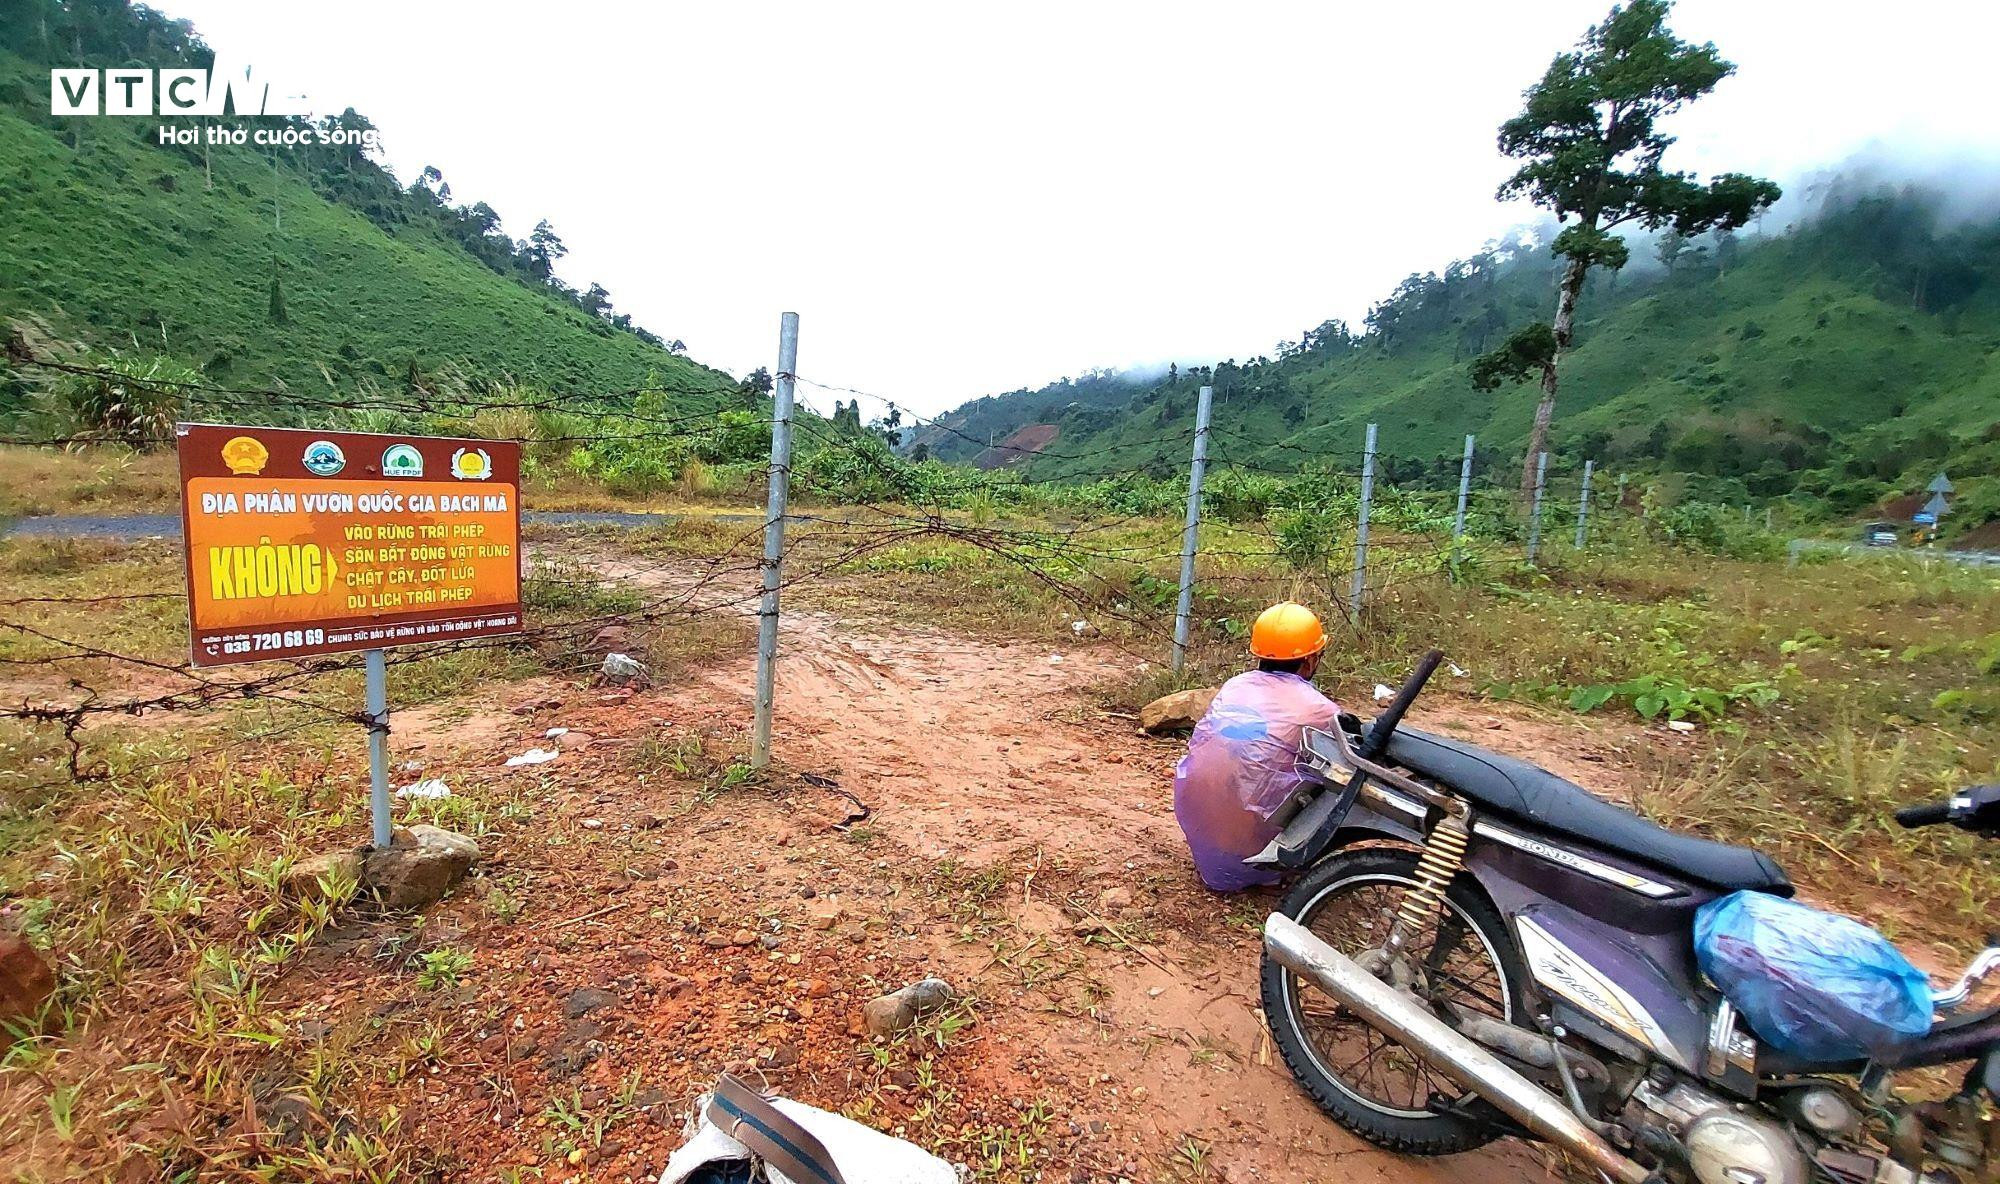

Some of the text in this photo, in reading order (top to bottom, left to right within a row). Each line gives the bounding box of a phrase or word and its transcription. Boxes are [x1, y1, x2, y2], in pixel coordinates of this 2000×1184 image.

[202, 488, 508, 518] ĐỊA PHẬN VƯỜN QUỐC GIA BẠCH MÃ
[344, 521, 485, 541] VÀO RỪNG TRÁI PHÉP
[345, 546, 375, 564] SĂN
[379, 542, 407, 562] BẮT
[410, 543, 446, 563] ĐỘNG
[450, 541, 475, 563] VẬT
[209, 536, 322, 600] KHÔNG
[346, 562, 475, 588] CHẶT CÂY, ĐỐT LỬA
[347, 585, 473, 610] DU LỊCH TRÁI PHÉP
[223, 628, 324, 655] 038 720 68 69
[327, 633, 353, 644] CHUNG
[354, 630, 369, 641] SỨC
[370, 627, 385, 640] BẢO
[385, 626, 396, 639] VỆ
[396, 626, 415, 637] RỪNG
[416, 624, 426, 635] VÀ
[426, 622, 440, 634] BẢO
[1517, 837, 1585, 869] HONDA
